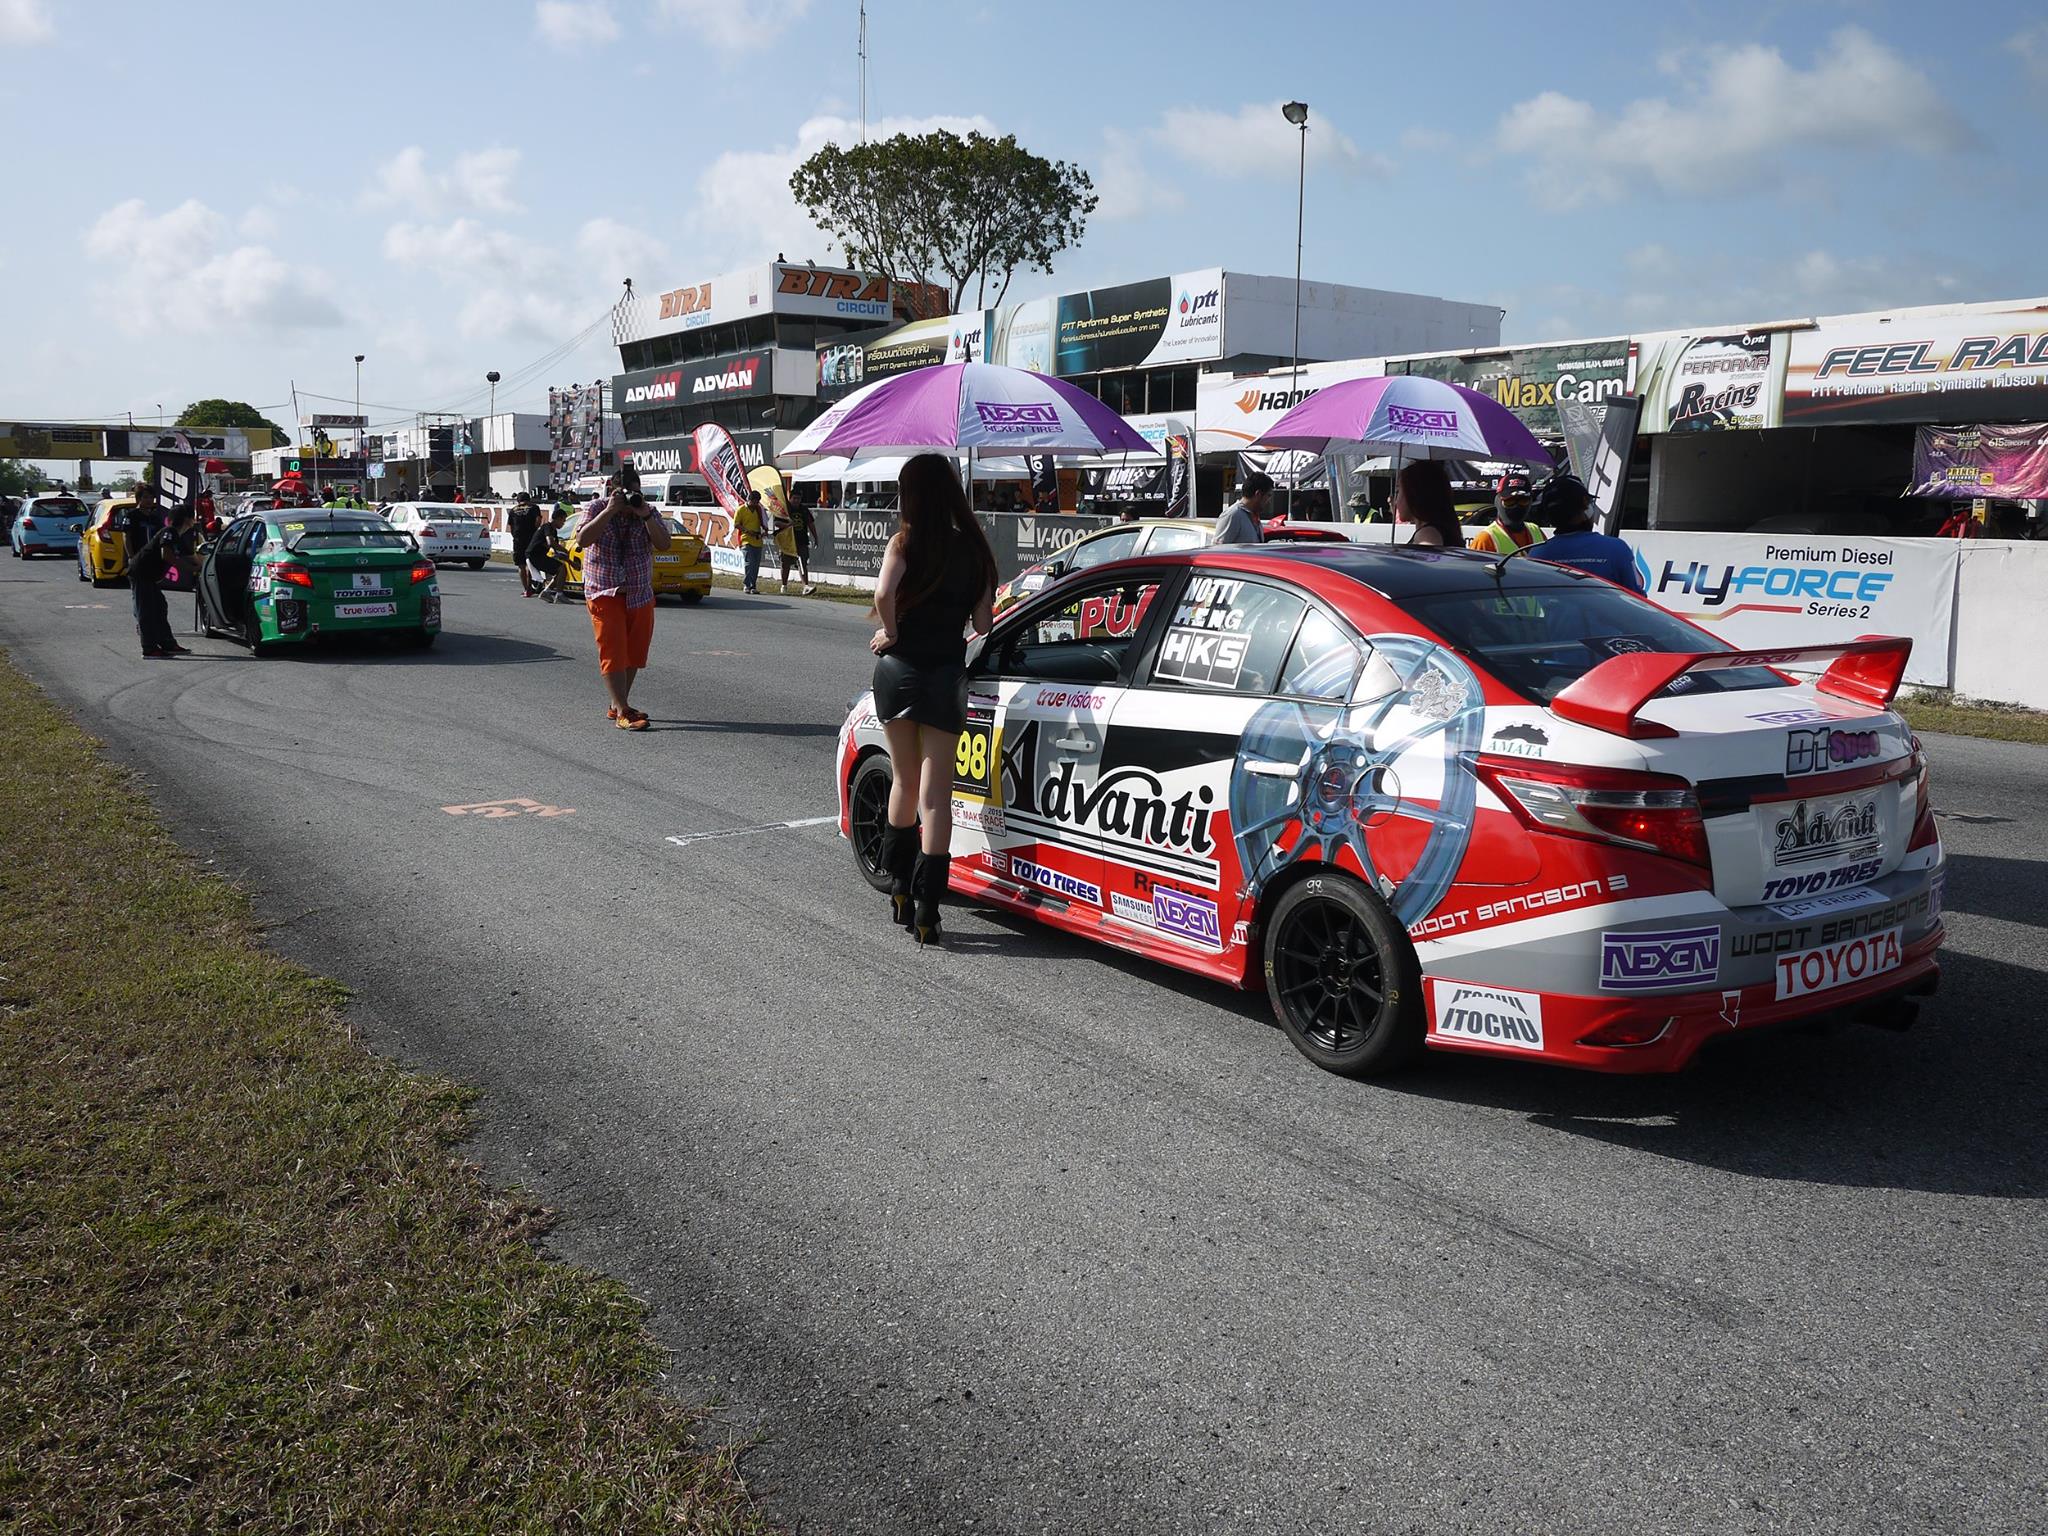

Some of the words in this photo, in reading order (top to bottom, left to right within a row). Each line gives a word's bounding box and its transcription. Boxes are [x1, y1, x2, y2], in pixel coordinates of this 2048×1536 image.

[777, 268, 889, 303] BIRA
[659, 283, 711, 320] BIRA
[836, 302, 887, 315] CIRCUIT
[1192, 289, 1218, 313] ptt
[686, 313, 710, 328] CIRCUIT
[1061, 320, 1076, 331] PTT
[1076, 316, 1109, 328] Performa
[1110, 313, 1132, 325] Super
[1133, 307, 1168, 321] Synthetic
[1180, 313, 1218, 327] Lubricants
[1163, 339, 1171, 347] The
[1171, 338, 1187, 347] Leader
[1194, 335, 1218, 343] Innovation
[1751, 335, 1766, 345] ptt
[1681, 356, 1768, 376] PERFORMA
[1814, 340, 1943, 379] FEEL
[625, 382, 676, 402] ADVAN
[692, 370, 752, 393] ADVAN
[1811, 385, 1834, 398] PTT
[1836, 383, 1885, 396] Performa
[1890, 380, 1928, 394] Racing
[1933, 377, 1986, 391] Synthetic
[1676, 382, 1763, 420] Racing
[976, 405, 1059, 421] NEXEN
[1388, 407, 1458, 428] NEXEN
[984, 425, 1025, 433] NEXEN
[1029, 425, 1064, 433] TIRES
[1389, 425, 1424, 436] NEXEN
[289, 461, 300, 471] 10
[632, 450, 682, 471] YOKOHAMA
[1480, 468, 1505, 477] Racing
[1507, 467, 1530, 476] Team
[847, 521, 889, 540] V-KOOL
[1766, 545, 1837, 563] Premium
[1842, 549, 1893, 565] Diesel
[1184, 577, 1246, 605] NOTTY
[1657, 560, 1894, 606] HyFORCE
[1807, 602, 1857, 618] Series
[1859, 605, 1870, 619] 2
[1163, 633, 1245, 669] HKS
[1667, 675, 1693, 692] TIGER
[956, 730, 987, 780] 98
[1487, 741, 1542, 757] AMATA
[1001, 720, 1214, 853] Advanti
[952, 800, 965, 809] IOS
[952, 808, 960, 819] NE
[962, 810, 983, 823] MAKE
[984, 815, 1004, 828] RACE
[1776, 800, 1876, 851] Advanti
[1013, 859, 1051, 886] TOYO
[1053, 873, 1099, 902] TIRES
[1306, 879, 1324, 893] 98
[1761, 872, 1826, 901] TOYO
[1825, 858, 1884, 890] TIRES
[1112, 894, 1153, 915] SAMSUNG
[1113, 905, 1155, 924] BUSINESS
[1408, 910, 1470, 937] WOOT
[1476, 880, 1602, 921] BANGBON
[1607, 874, 1629, 891] 3
[1154, 896, 1219, 937] NEXEN
[1731, 926, 1813, 958] WOOT
[1602, 937, 1720, 978] NEXEN
[1777, 931, 1900, 994] TOYOTA
[1441, 1007, 1540, 1044] ITOCHU
